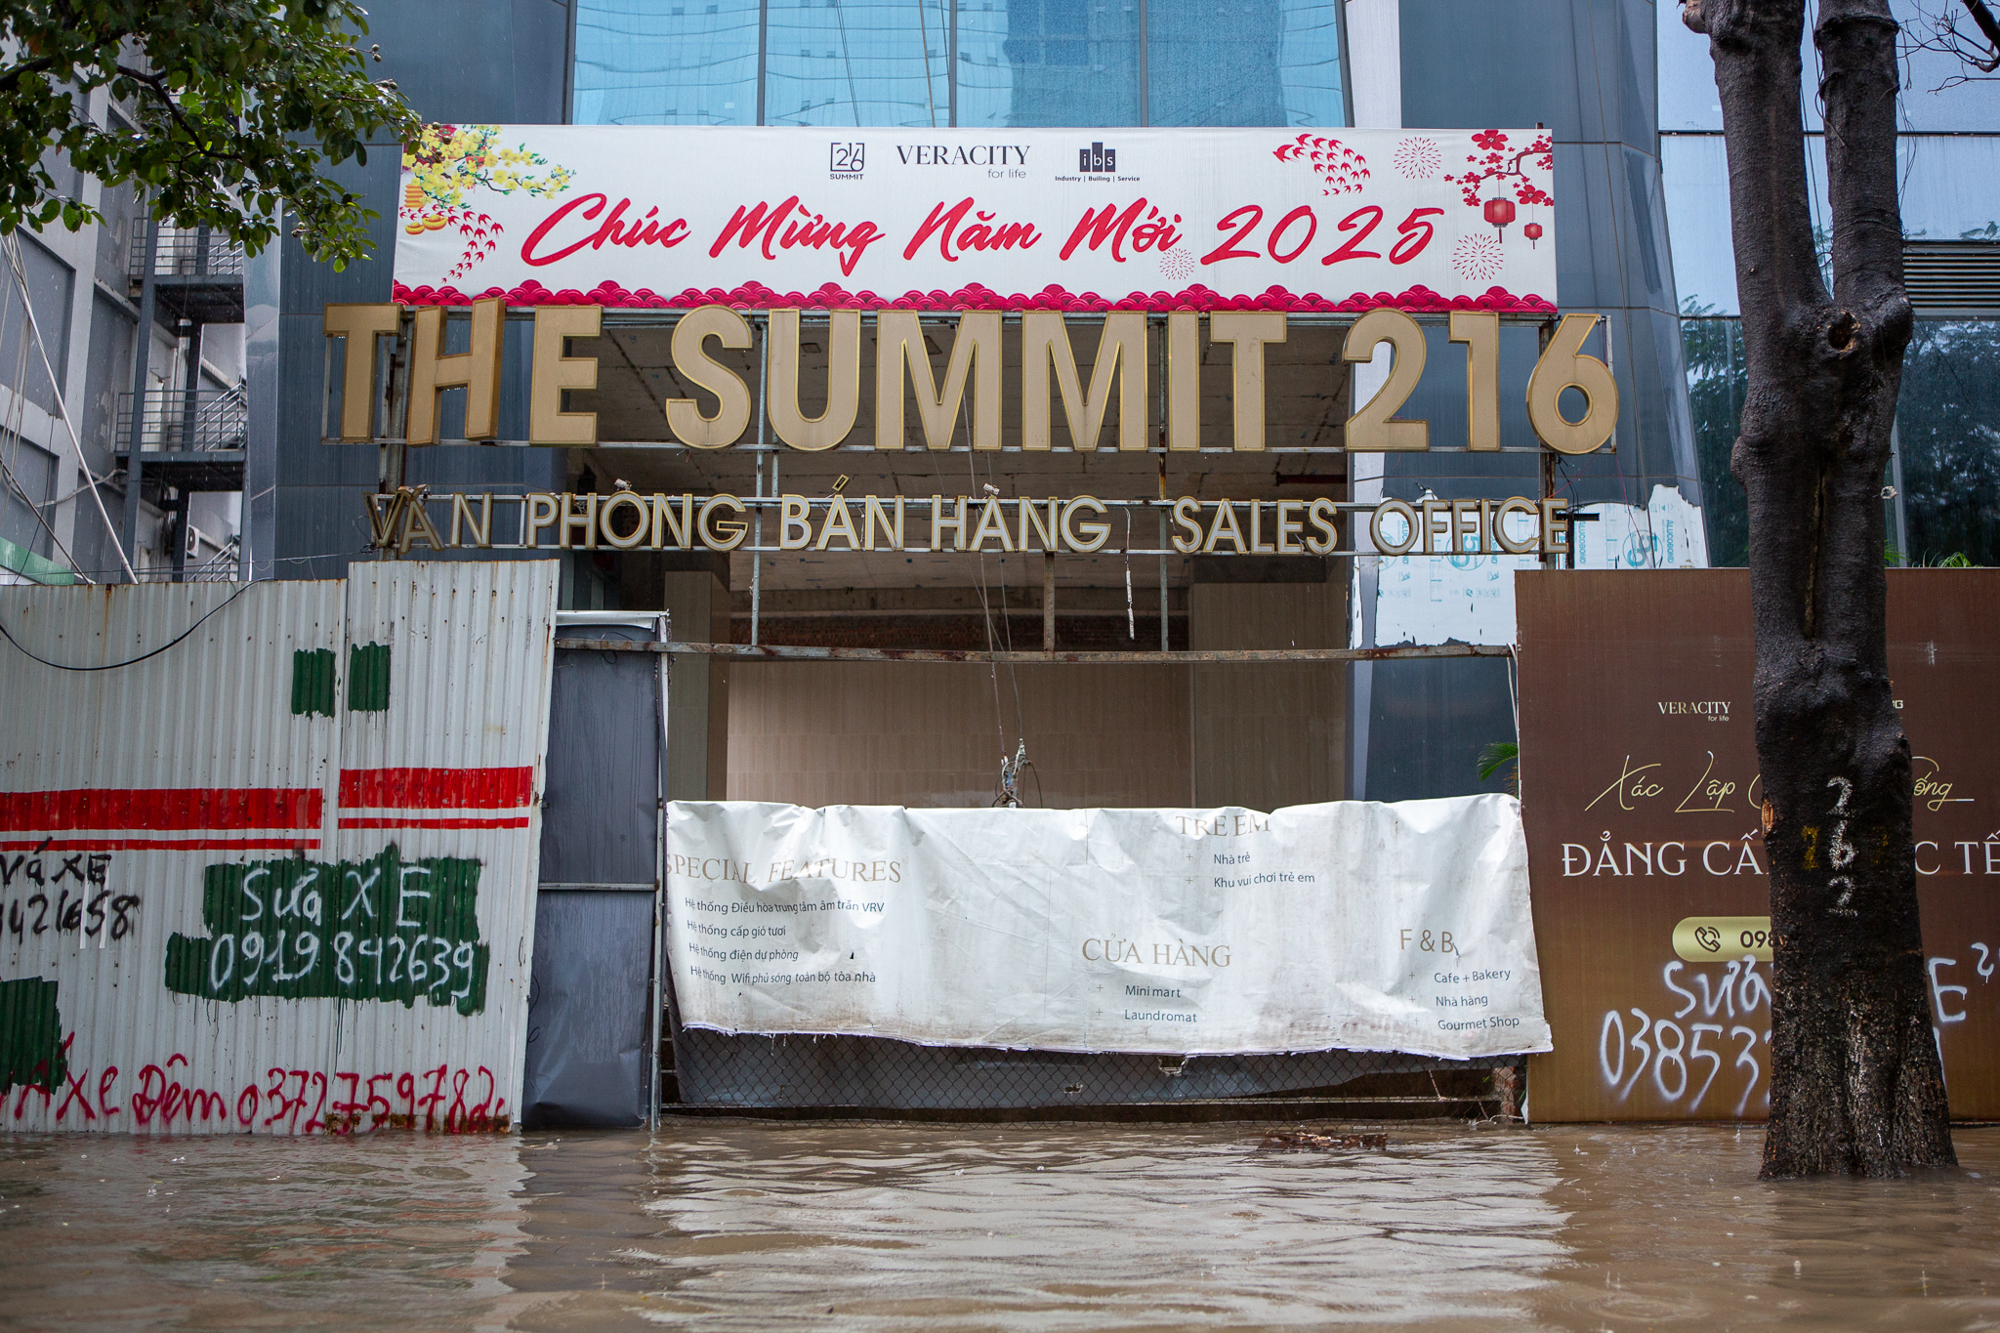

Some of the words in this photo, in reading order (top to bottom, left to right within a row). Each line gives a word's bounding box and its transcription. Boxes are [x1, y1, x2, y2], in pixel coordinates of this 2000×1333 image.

[896, 145, 1031, 165] VERACITY
[987, 168, 1004, 179] for
[1008, 168, 1027, 179] life
[520, 192, 691, 267] Chúc
[709, 195, 886, 277] Mừng
[903, 196, 1042, 262] Năm
[1059, 197, 1183, 263] Mới
[1200, 205, 1445, 267] 2025
[324, 298, 603, 448] THE
[666, 304, 1287, 452] SUMMIT
[1343, 308, 1620, 455] 216
[779, 474, 904, 551] BÁN
[1172, 496, 1338, 555] SALES
[1370, 496, 1569, 556] OFFICE
[1658, 701, 1731, 715] VERACITY
[1585, 755, 1664, 811] Xác
[1675, 751, 1735, 813] Lập
[1213, 854, 1235, 865] Nhà
[1702, 828, 1769, 877] CẤ
[768, 857, 901, 884] FEATURES
[1213, 877, 1235, 888] Khu
[1237, 875, 1252, 887] vui
[1253, 872, 1277, 884] chơi
[1297, 874, 1316, 883] em
[0, 889, 140, 941] 421658
[697, 901, 729, 915] thống
[774, 902, 798, 915] trung
[799, 901, 817, 912] tâm
[820, 900, 835, 911] âm
[862, 902, 885, 912] VRV
[698, 924, 727, 939] thống
[730, 925, 750, 939] cấp
[751, 926, 767, 939] gió
[1400, 929, 1412, 950] F
[1420, 929, 1435, 952] &
[1441, 931, 1454, 953] B
[700, 946, 727, 963] thống
[729, 949, 753, 963] điện
[769, 949, 799, 962] phòng
[1152, 938, 1232, 968] HÀNG
[702, 968, 726, 986] thống
[731, 972, 750, 984] Wifi
[771, 972, 792, 985] sóng
[854, 971, 876, 983] nhà
[1434, 972, 1460, 984] Cafe
[1463, 975, 1470, 983] +
[1472, 969, 1511, 981] Bakery
[1125, 984, 1150, 997] Mini
[1152, 987, 1181, 998] mart
[1436, 996, 1458, 1008] Nhà
[1461, 996, 1488, 1008] hàng
[1124, 1009, 1197, 1023] Laundromat
[1438, 1019, 1487, 1031] Gourmet
[1489, 1016, 1520, 1029] Shop
